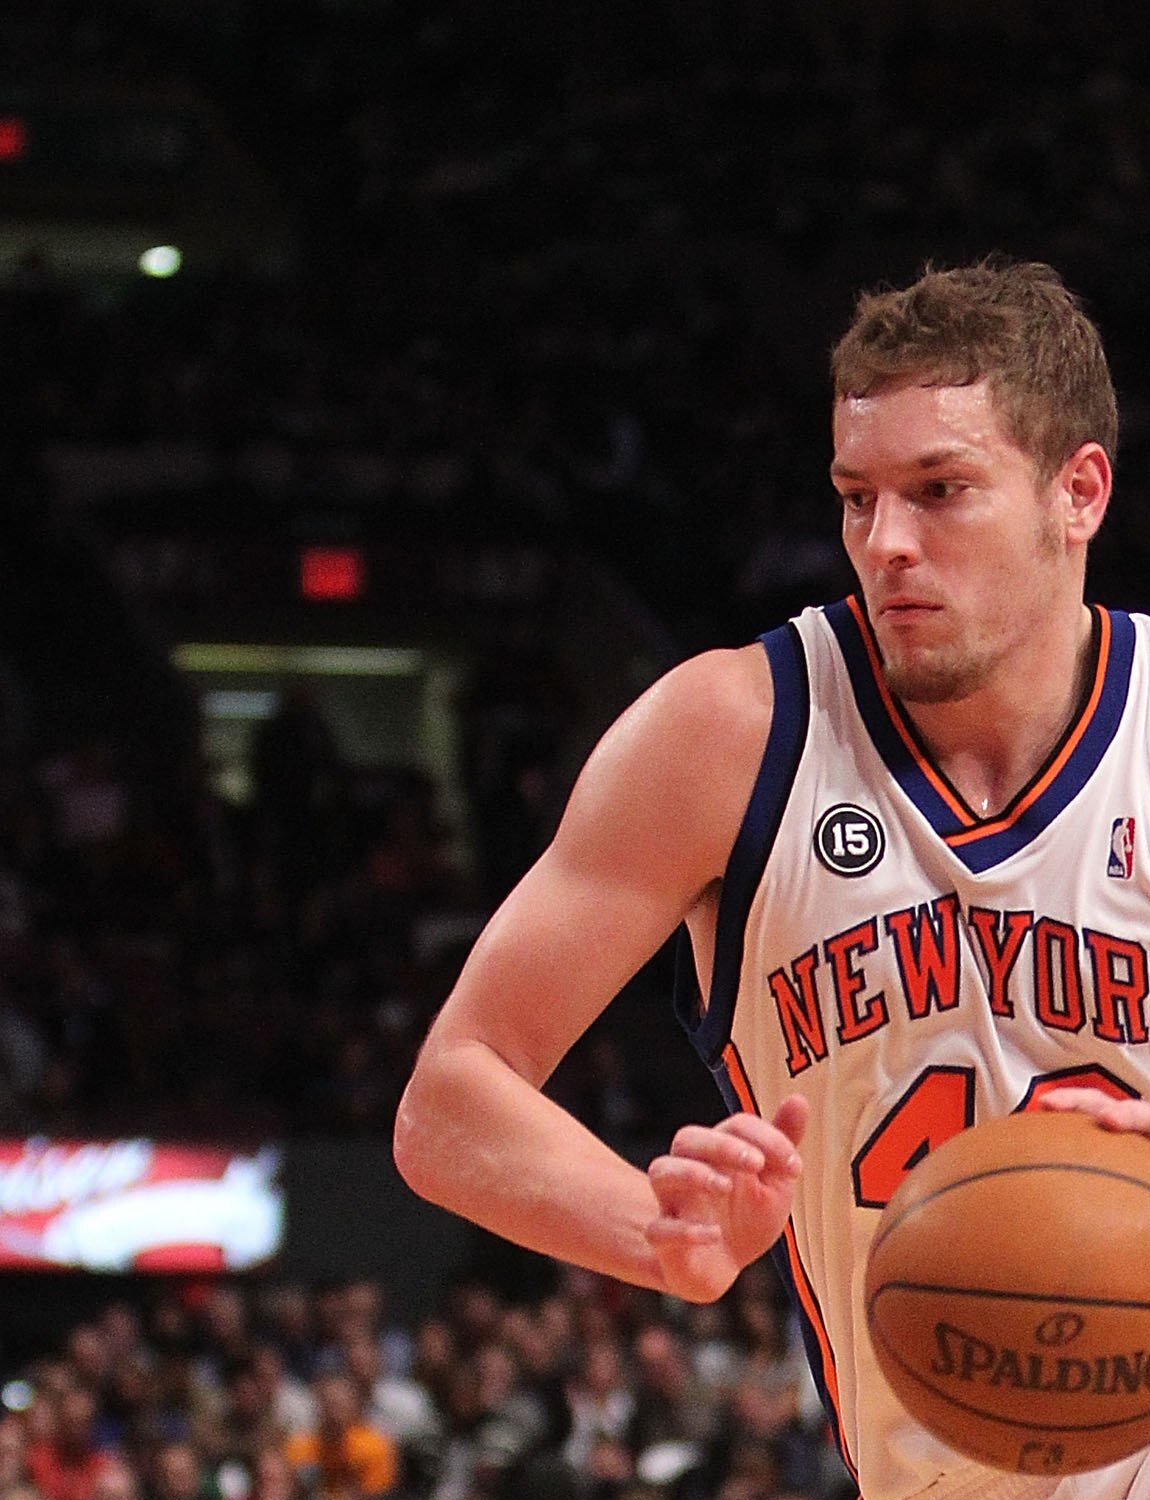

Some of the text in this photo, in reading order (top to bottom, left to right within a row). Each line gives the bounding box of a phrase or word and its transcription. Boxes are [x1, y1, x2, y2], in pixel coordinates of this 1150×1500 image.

[832, 822, 870, 857] 15
[768, 893, 964, 1078] NEW
[851, 1063, 1142, 1209] 4
